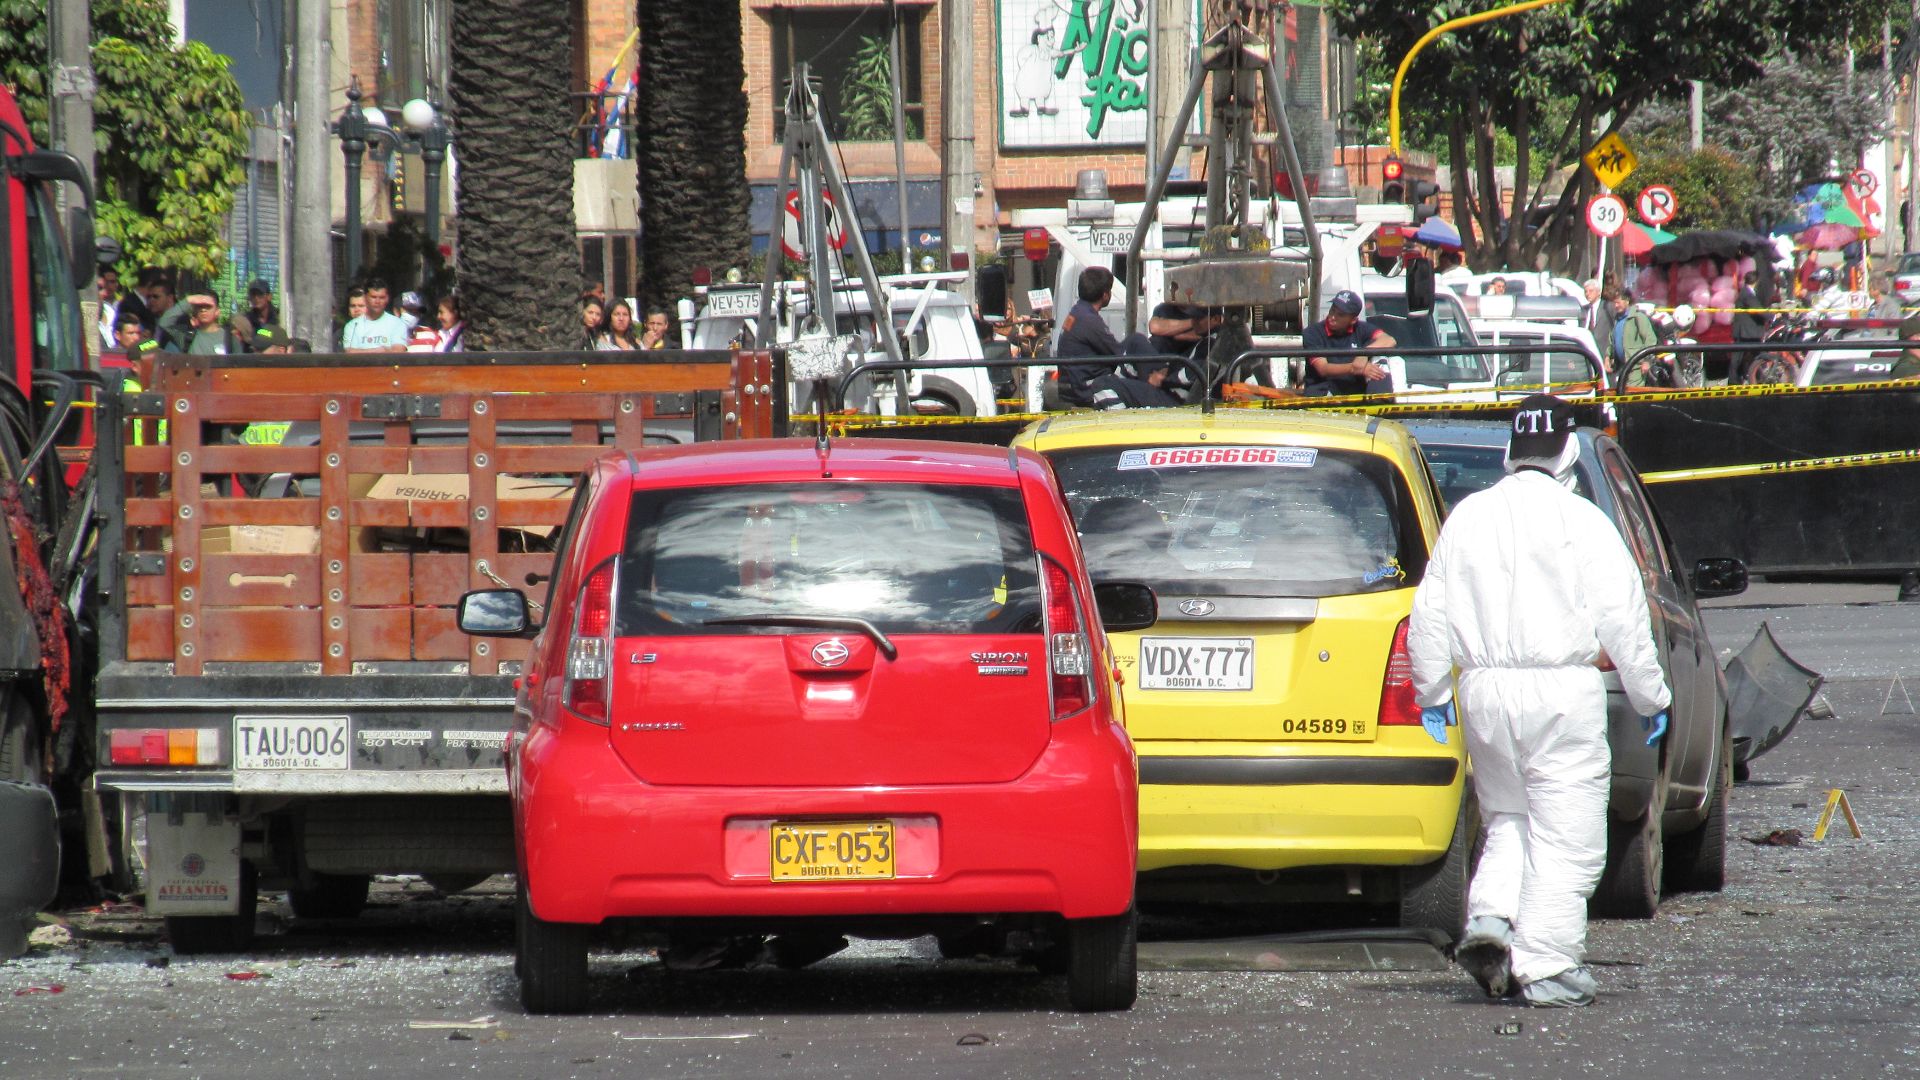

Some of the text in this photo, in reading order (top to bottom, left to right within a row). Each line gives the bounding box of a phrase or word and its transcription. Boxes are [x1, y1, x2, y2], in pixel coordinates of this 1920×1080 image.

[1597, 206, 1617, 222] 30
[1515, 409, 1554, 433] CTI
[396, 486, 450, 500] ARRIBA
[970, 652, 1028, 663] SIRION
[1166, 678, 1203, 687] BOGOTA
[1282, 719, 1347, 733] 04589
[365, 739, 385, 747] 80
[263, 758, 298, 767] BOGOTA
[801, 866, 840, 876] BOGOTA
[160, 885, 228, 894] ATLANTIS
